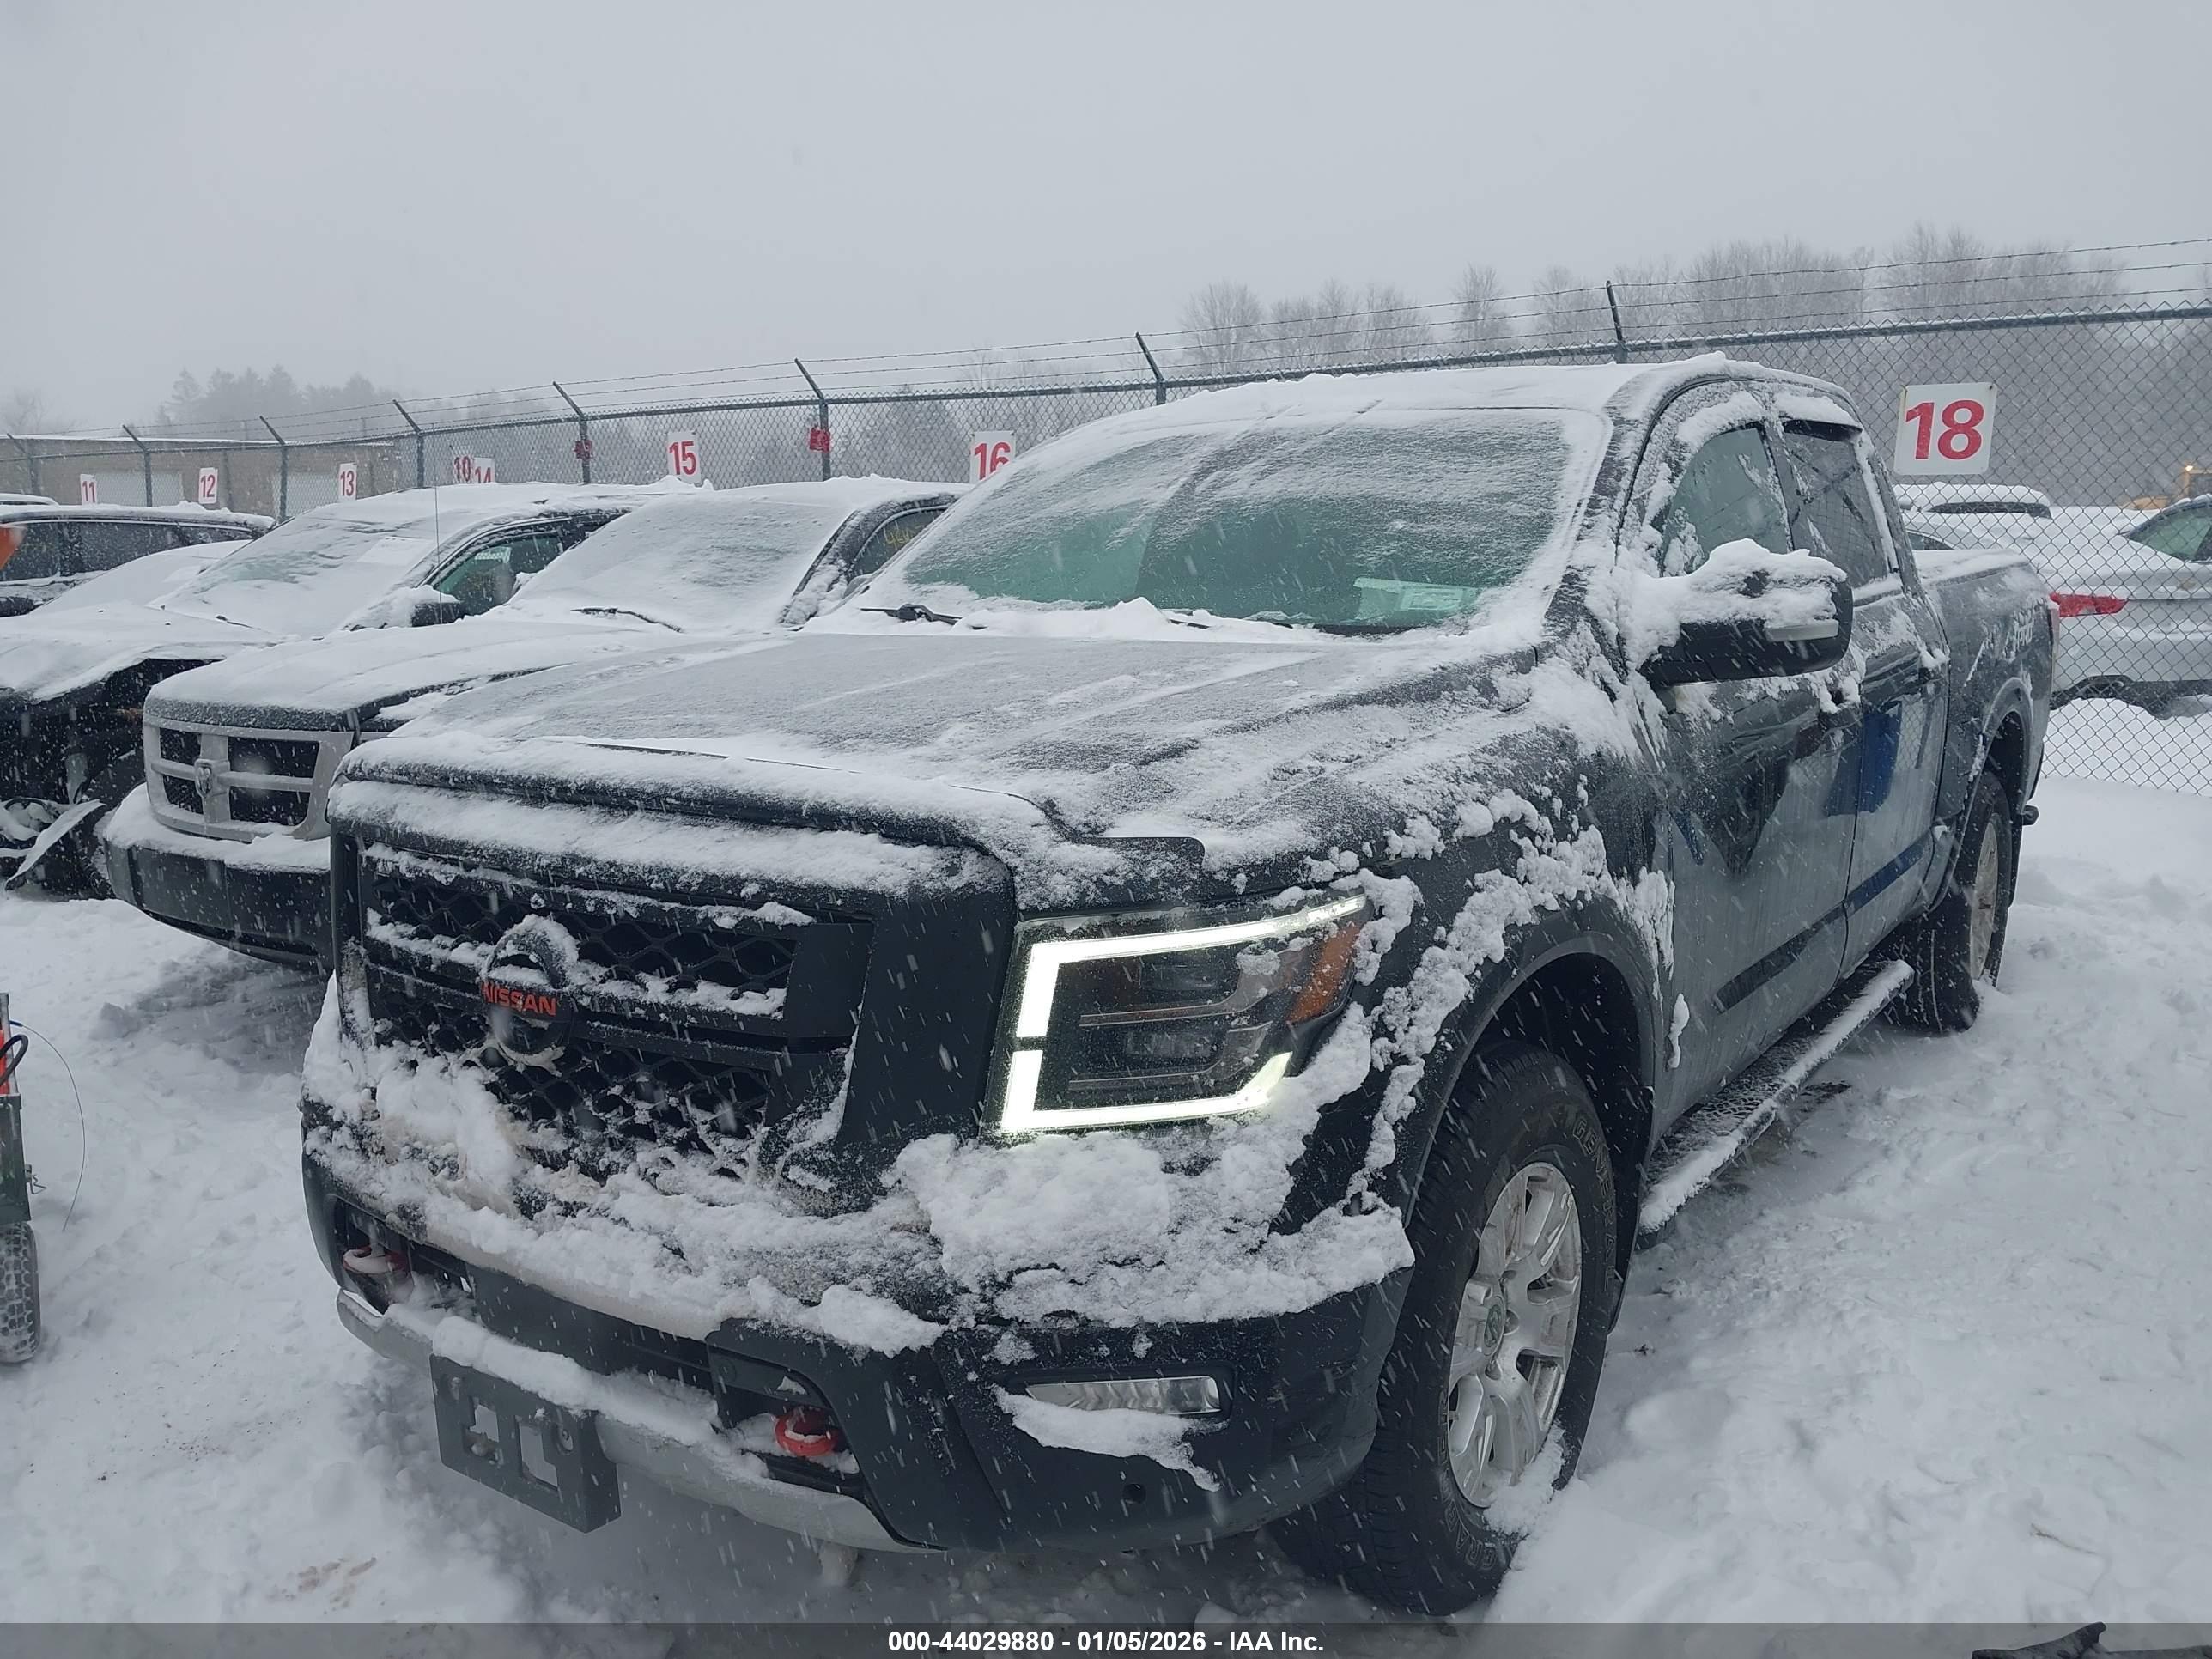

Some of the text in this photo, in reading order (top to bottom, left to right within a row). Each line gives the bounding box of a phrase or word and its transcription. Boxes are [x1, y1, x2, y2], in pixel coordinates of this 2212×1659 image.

[1905, 400, 1984, 459] 18
[453, 456, 471, 482] 10
[669, 441, 696, 475] 15
[975, 441, 1010, 480] 16
[82, 480, 95, 503] 11
[200, 474, 216, 497] 12
[340, 471, 355, 496] 13
[482, 981, 556, 1017] NISSAN
[1572, 1117, 1617, 1292] GENERAL
